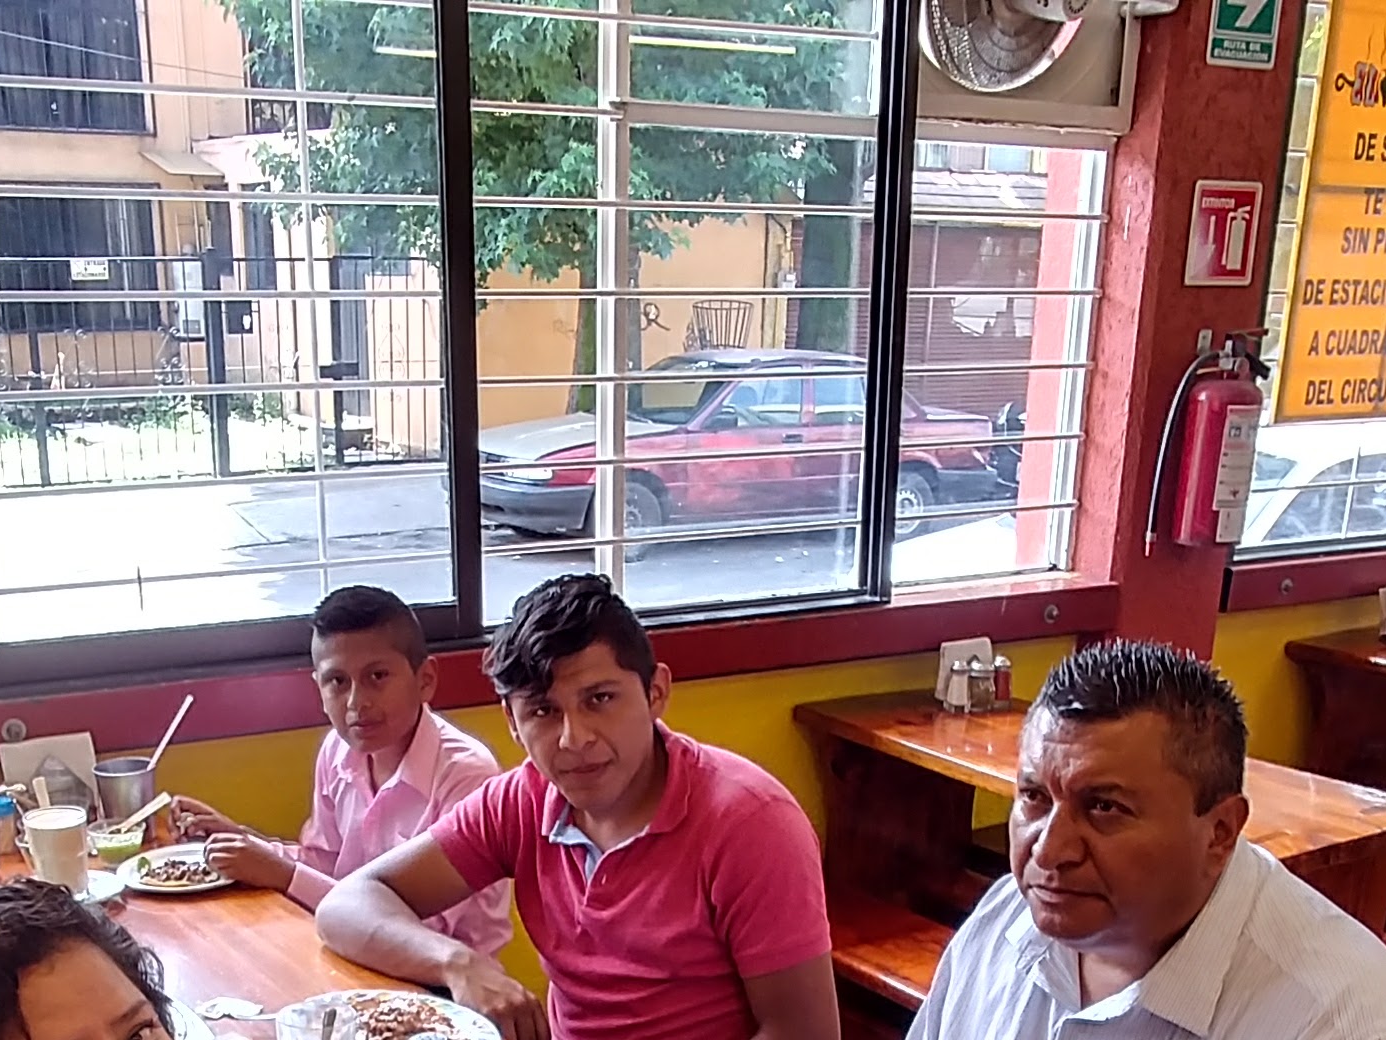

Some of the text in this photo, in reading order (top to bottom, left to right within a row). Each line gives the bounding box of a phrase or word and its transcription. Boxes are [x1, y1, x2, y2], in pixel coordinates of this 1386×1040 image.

[1224, 40, 1261, 51] RUTA DE
[1351, 61, 1378, 107] EL
[1354, 132, 1378, 161] DE
[1364, 188, 1384, 215] TE
[1341, 227, 1371, 254] SIN
[1302, 279, 1326, 305] DE
[1308, 330, 1320, 356] A
[1304, 380, 1334, 406] DEL
